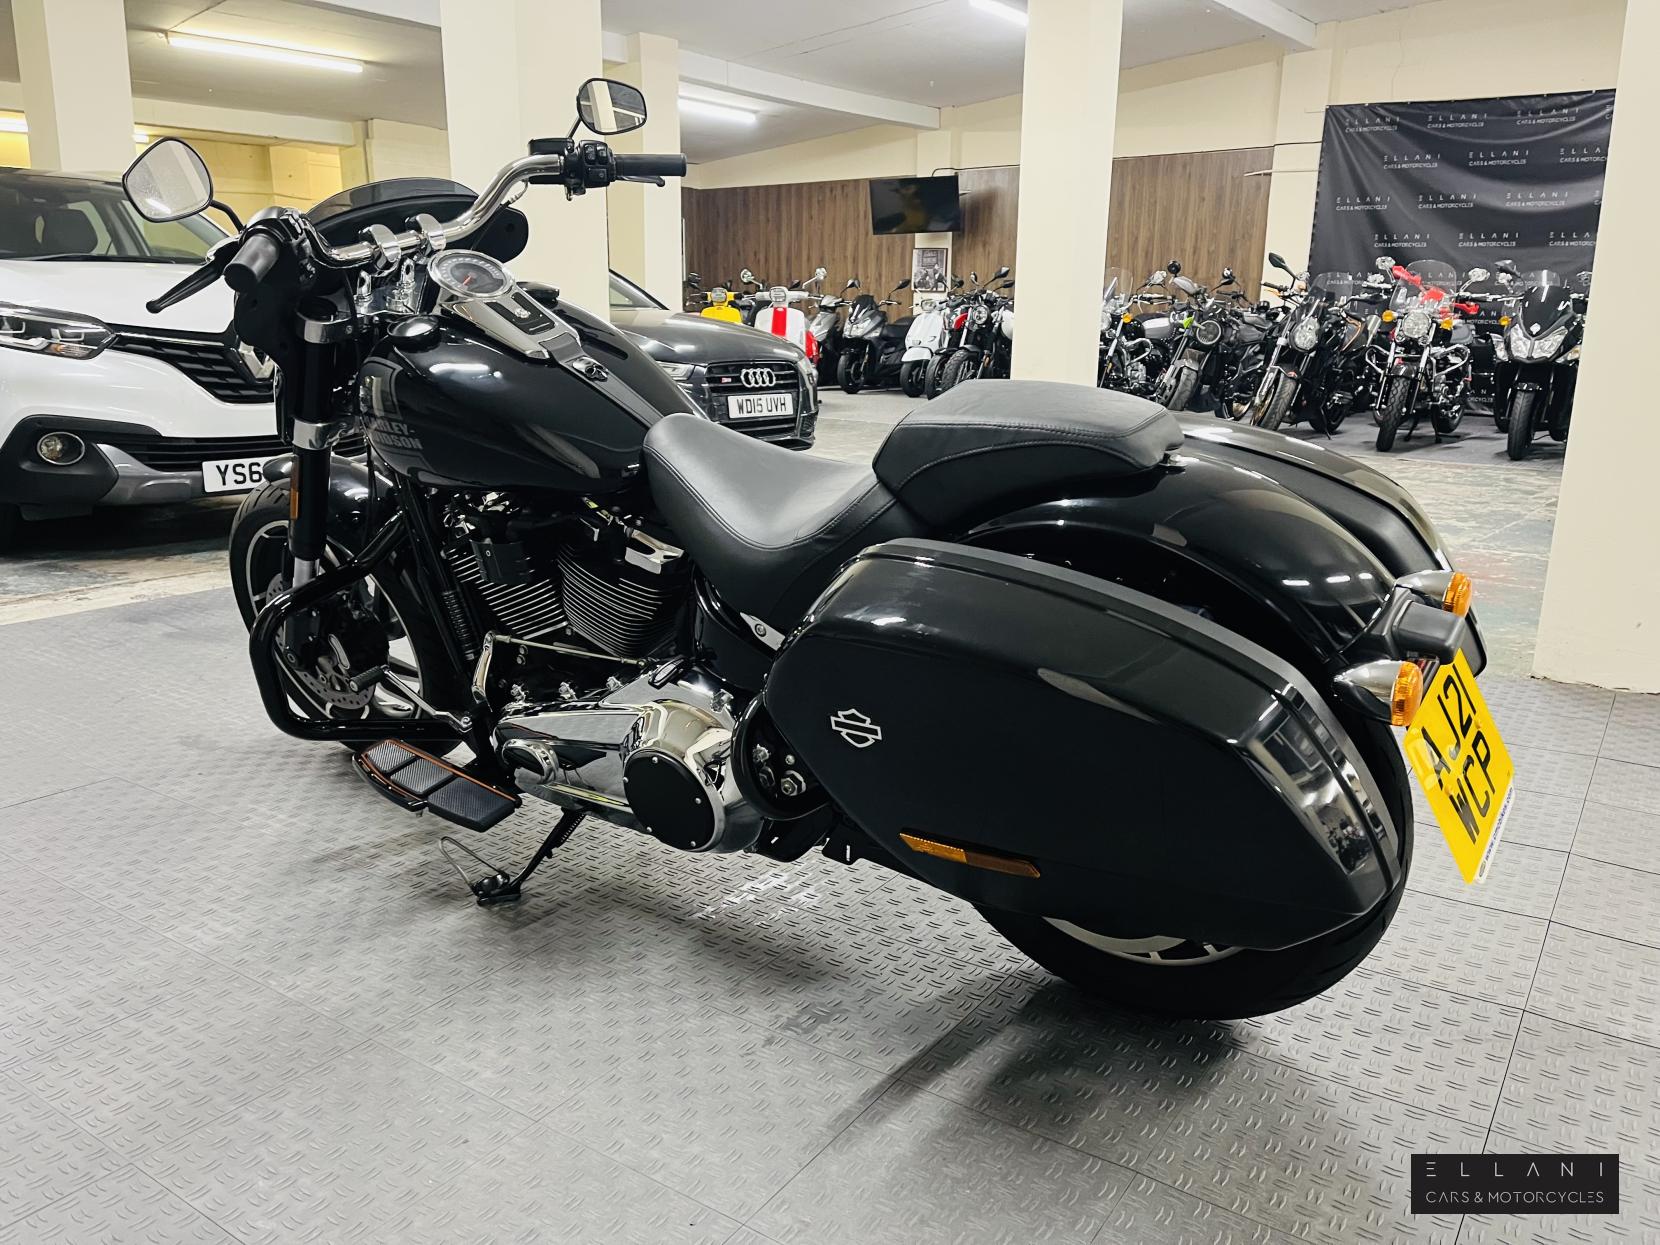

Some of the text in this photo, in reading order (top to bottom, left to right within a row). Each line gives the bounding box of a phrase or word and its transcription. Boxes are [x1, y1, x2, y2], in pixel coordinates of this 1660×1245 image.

[736, 397, 787, 414] WD15 UVH
[216, 462, 263, 486] YS6
[1421, 663, 1477, 791] AJ21
[1449, 730, 1496, 845] WCP
